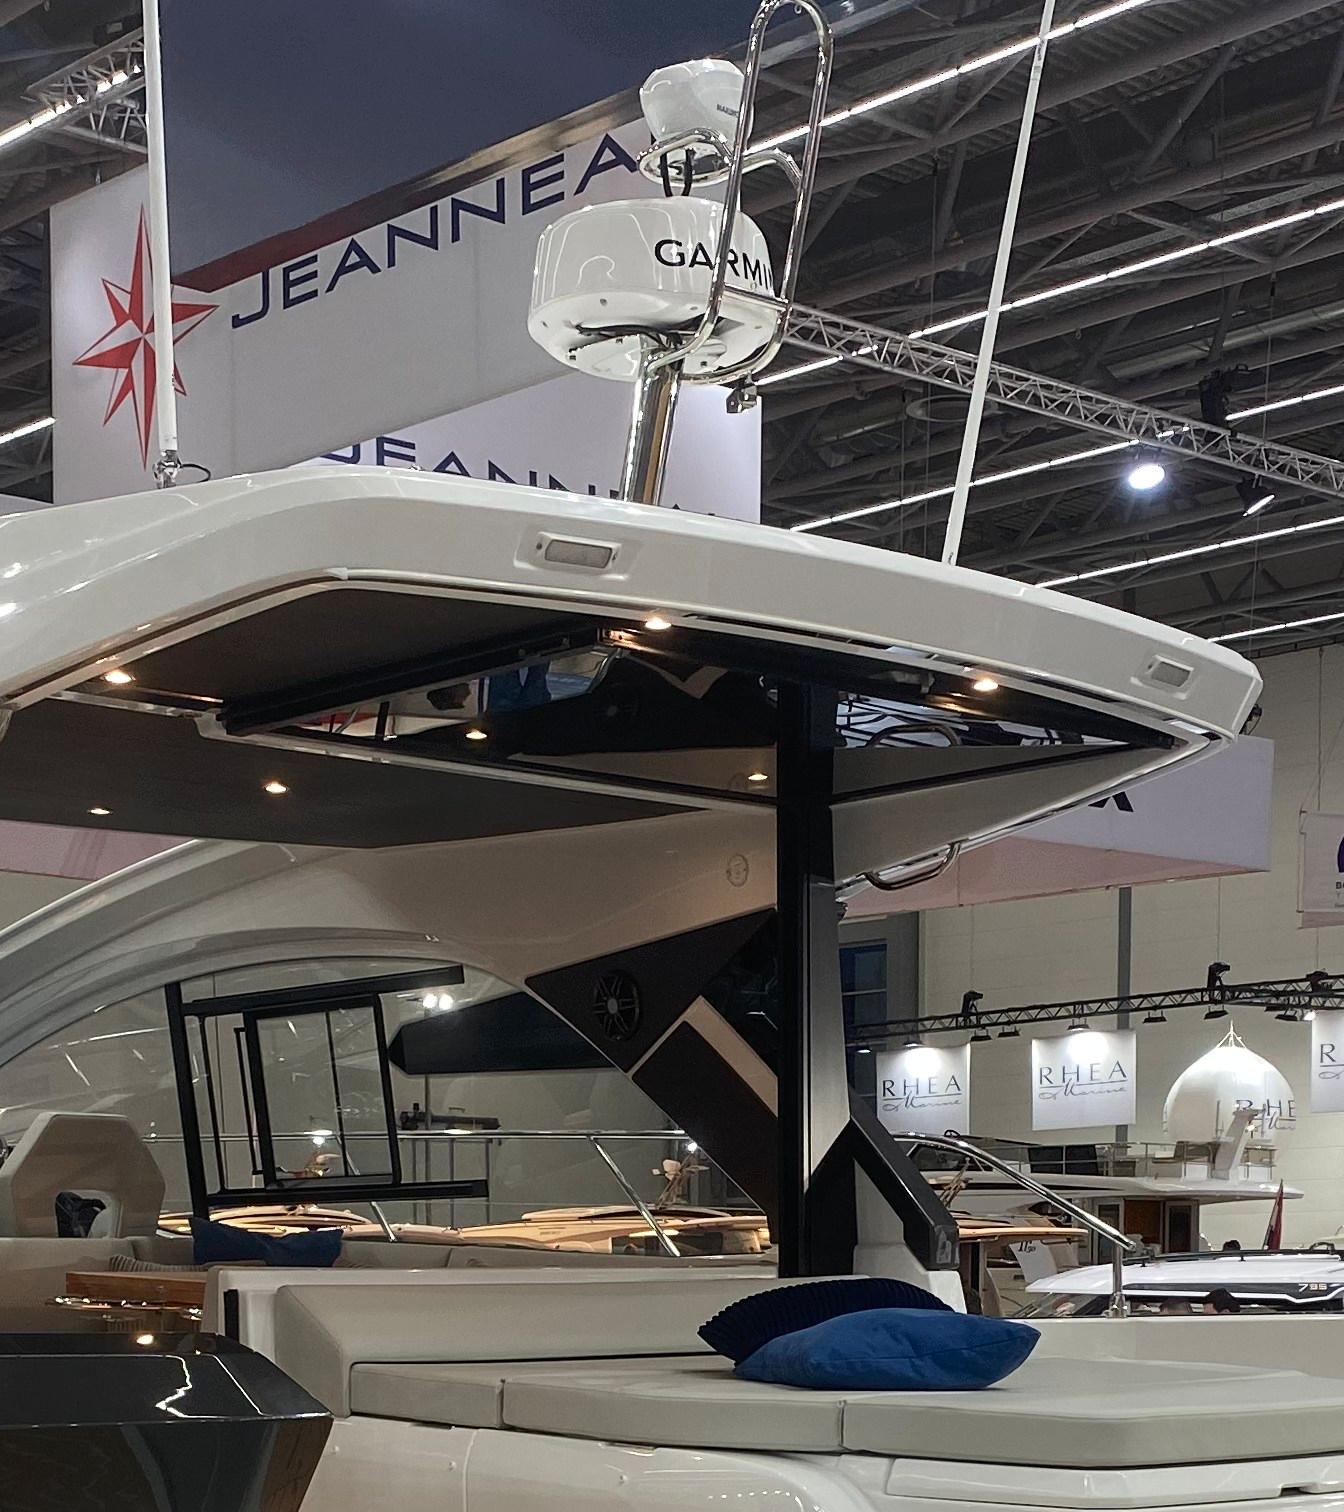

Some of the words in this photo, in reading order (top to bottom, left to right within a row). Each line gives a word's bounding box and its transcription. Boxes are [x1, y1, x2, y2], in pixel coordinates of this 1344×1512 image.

[231, 132, 657, 330] JEANNEA
[1039, 1060, 1128, 1085] RHEA
[882, 1075, 962, 1097] RHEA
